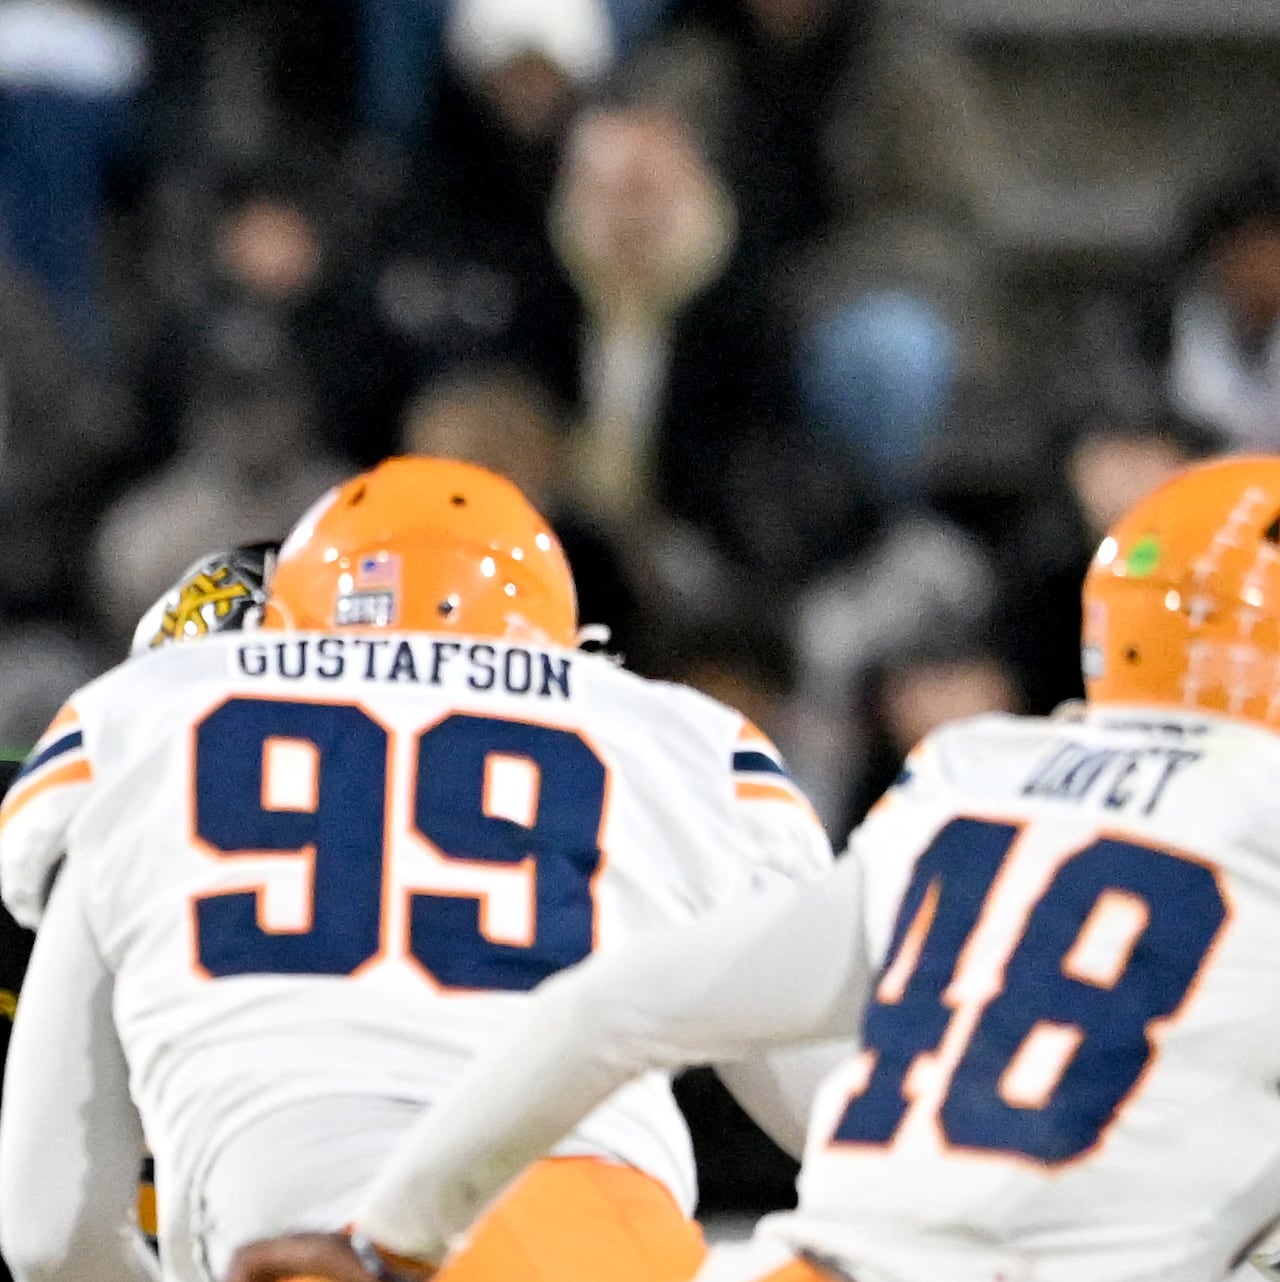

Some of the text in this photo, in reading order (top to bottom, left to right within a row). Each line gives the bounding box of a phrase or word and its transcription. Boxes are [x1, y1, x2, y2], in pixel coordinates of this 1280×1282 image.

[238, 635, 574, 700] GUSTAFSON
[190, 694, 612, 996] 99
[824, 814, 1235, 1177] 48
